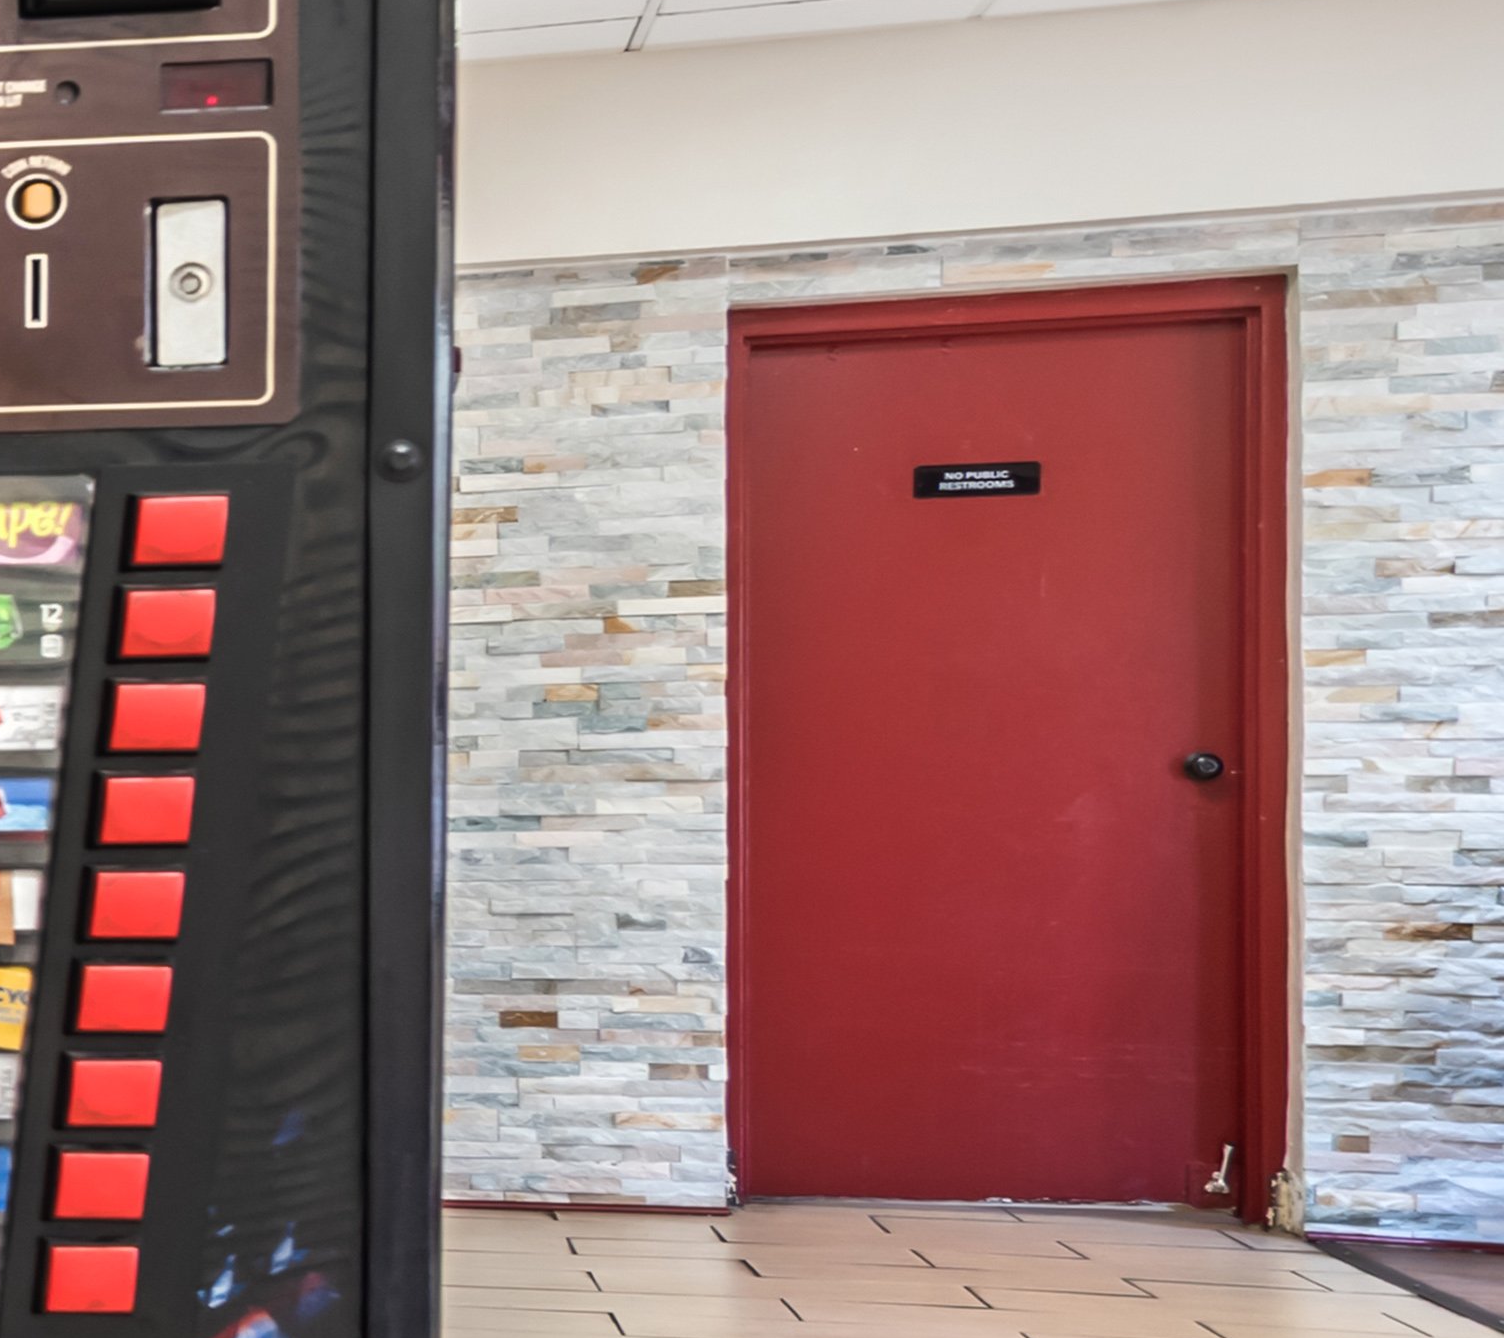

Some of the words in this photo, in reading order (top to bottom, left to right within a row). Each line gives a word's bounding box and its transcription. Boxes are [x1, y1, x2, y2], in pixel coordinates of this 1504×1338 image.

[943, 472, 964, 481] NO
[965, 470, 1010, 480] PUBLIC
[938, 480, 1015, 491] RESTROOMS
[39, 603, 64, 624] 12
